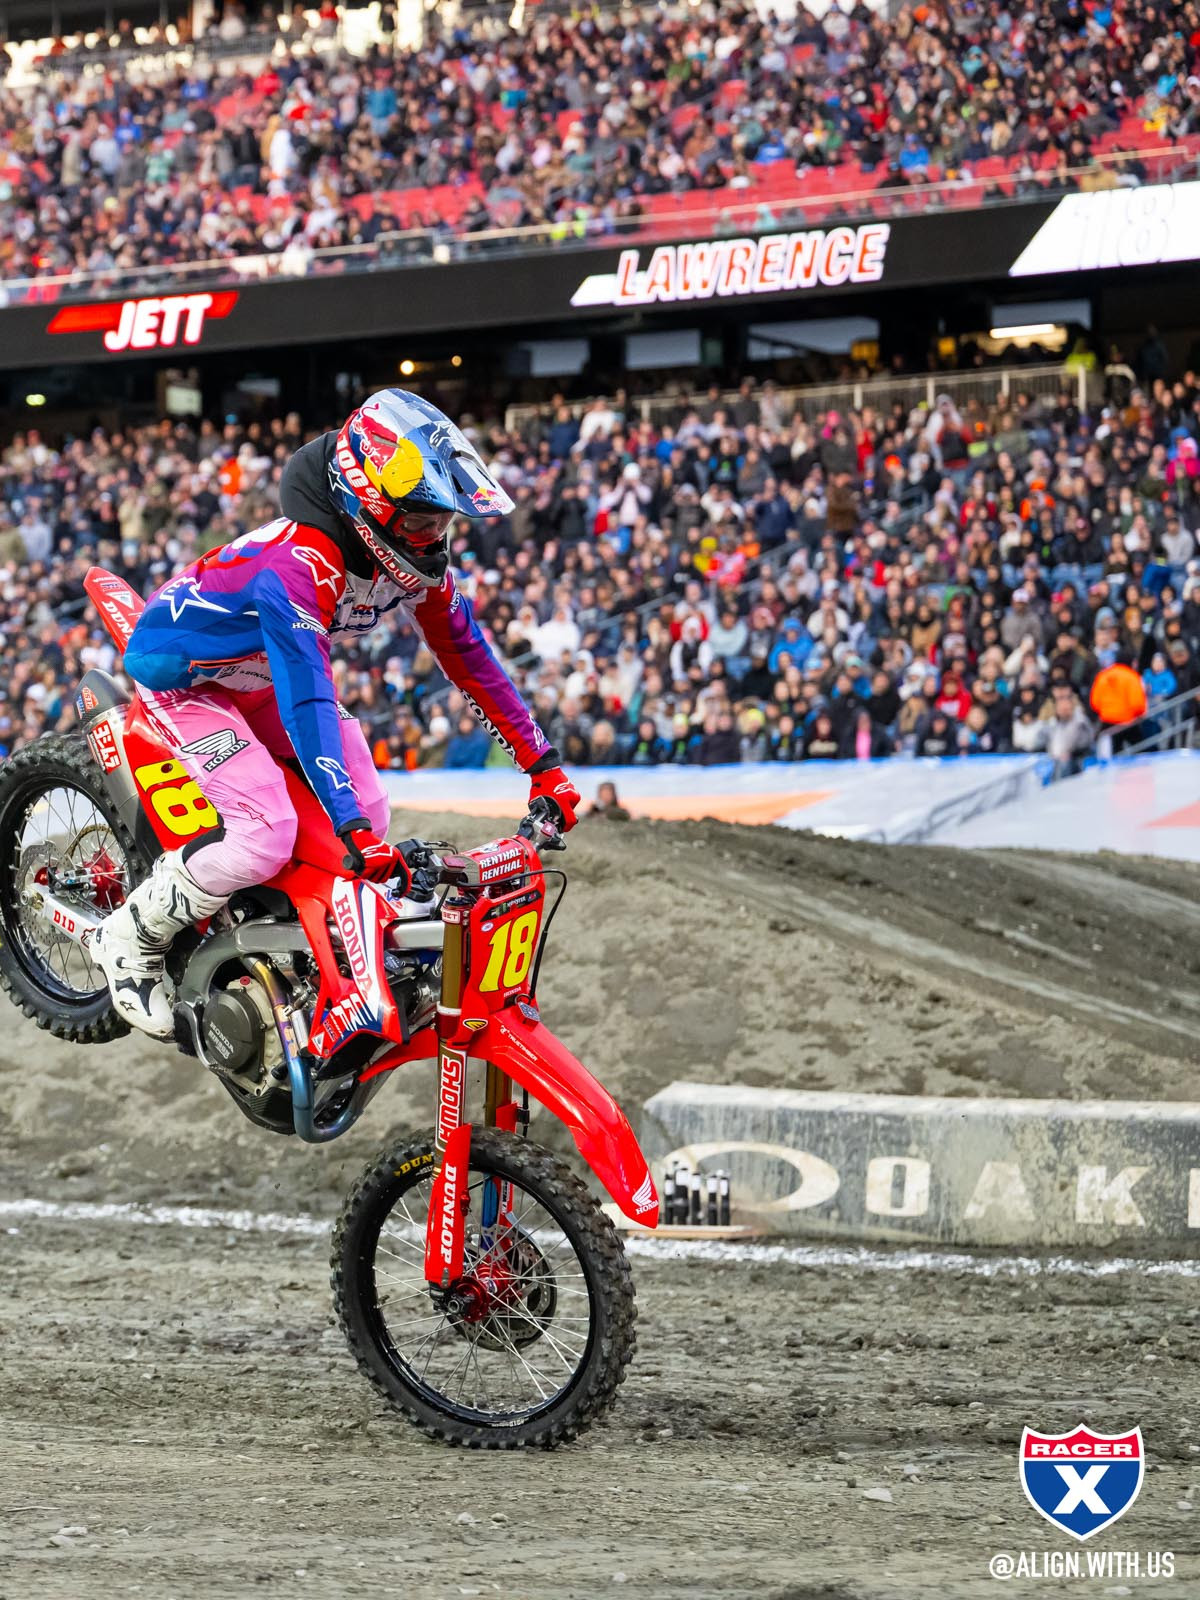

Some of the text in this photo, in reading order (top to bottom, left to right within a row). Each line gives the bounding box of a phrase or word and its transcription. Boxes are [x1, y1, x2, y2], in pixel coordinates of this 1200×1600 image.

[613, 223, 890, 306] LAWRENCE
[104, 294, 213, 351] JETT
[337, 434, 391, 517] 100%
[292, 622, 330, 641] HON
[206, 739, 249, 772] HONDA
[134, 758, 220, 836] 18
[479, 848, 522, 869] RENTHAL
[481, 860, 523, 882] RENTHAL
[53, 910, 76, 934] DID
[335, 894, 374, 999] HONDA
[479, 910, 538, 993] 18
[210, 1021, 234, 1053] HONDA
[439, 1055, 462, 1142] SHOWA
[400, 1153, 433, 1174] DUN
[441, 1163, 457, 1265] DUNLOP
[636, 1199, 659, 1215] HONDA
